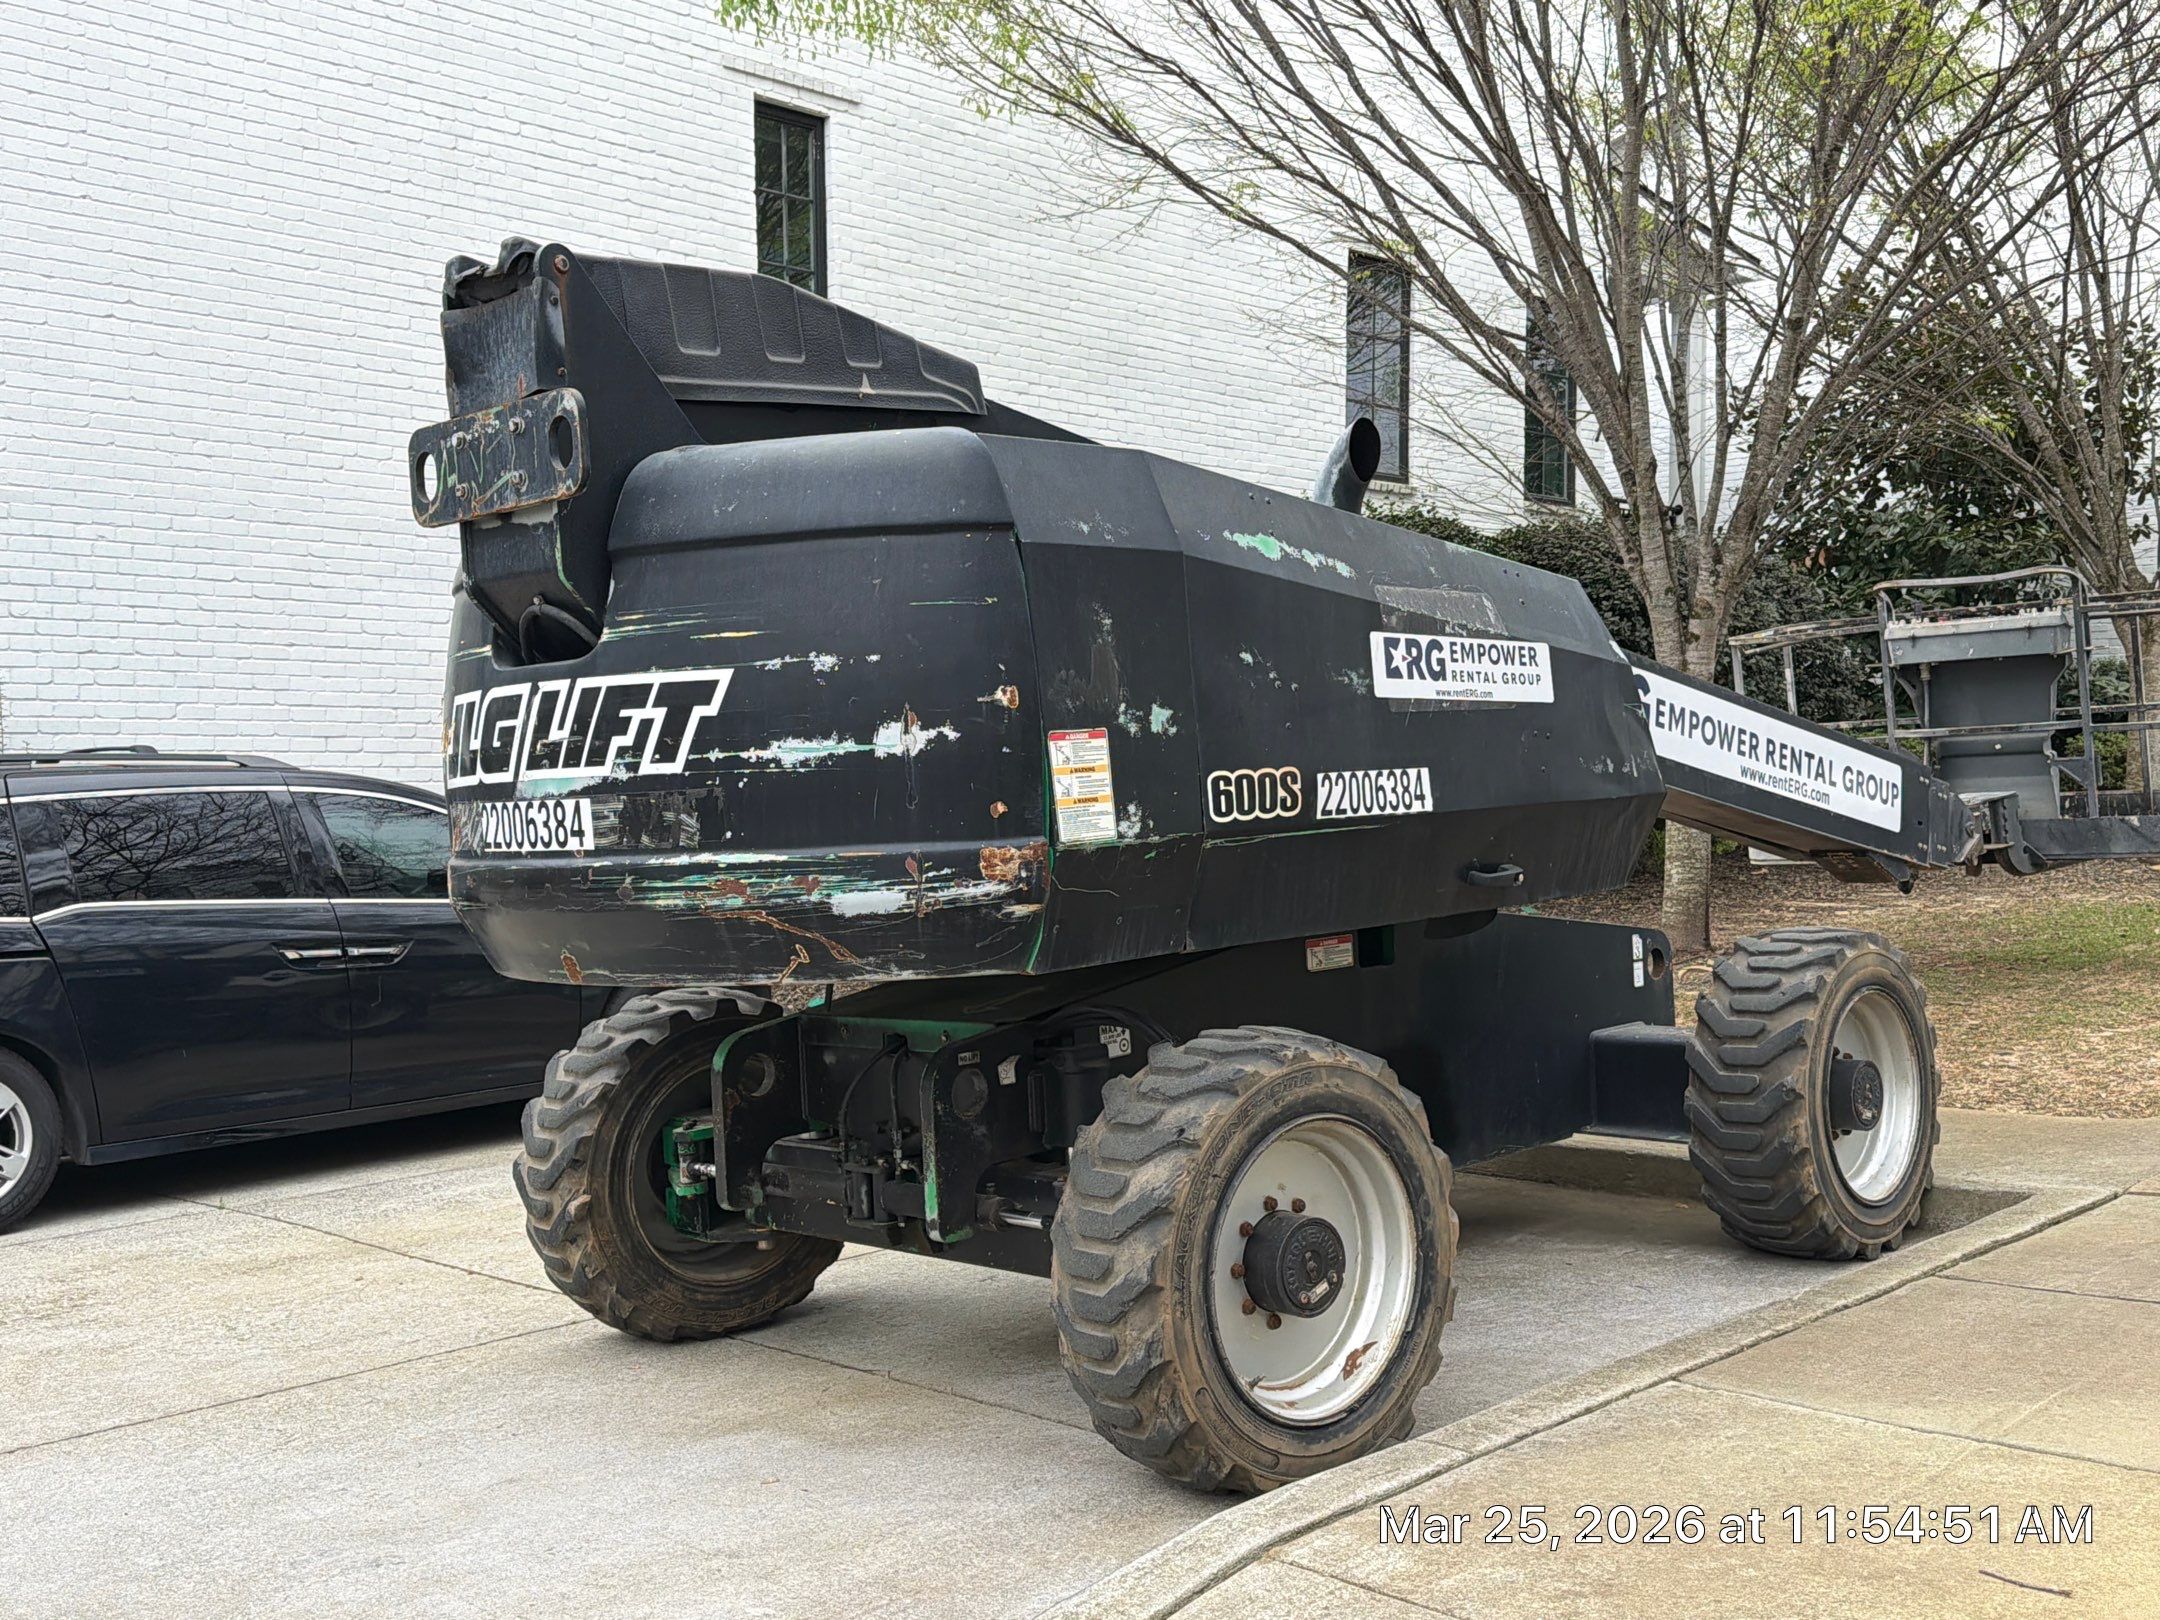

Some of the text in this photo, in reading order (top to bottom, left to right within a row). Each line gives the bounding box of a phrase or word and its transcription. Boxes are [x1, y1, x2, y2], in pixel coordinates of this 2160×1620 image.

[1383, 637, 1539, 681] ERG EMPOWER
[1452, 670, 1541, 685] RENTAL GROUP
[1435, 689, 1494, 699] www.rentERG.com
[1654, 698, 1760, 761] EMPOWER
[1765, 737, 1837, 788] RENTAL
[1842, 765, 1900, 808] GROUP
[1207, 766, 1301, 823] 600S
[1320, 769, 1427, 818] 22006384
[1740, 765, 1830, 806] www.rentERG.com
[482, 800, 586, 850] 22006384
